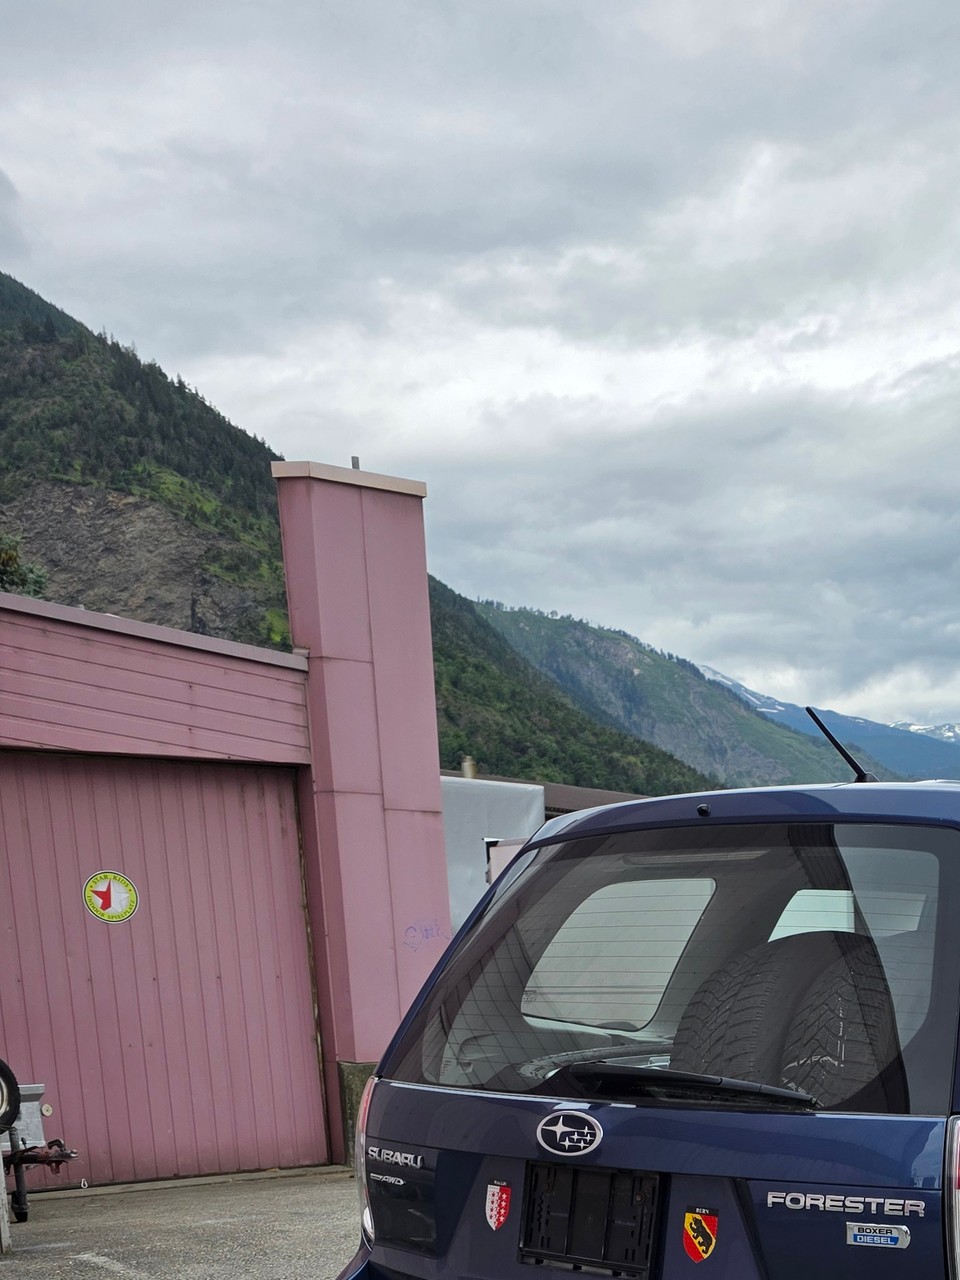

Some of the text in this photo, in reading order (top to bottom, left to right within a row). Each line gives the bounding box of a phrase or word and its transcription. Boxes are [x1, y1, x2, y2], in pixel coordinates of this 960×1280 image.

[91, 874, 130, 888] STAR KIDS
[368, 1146, 423, 1169] SUBARU
[381, 1175, 405, 1186] AWD
[767, 1191, 926, 1217] FORESTER
[857, 1227, 893, 1236] BOXER
[856, 1235, 895, 1246] DIESEL
